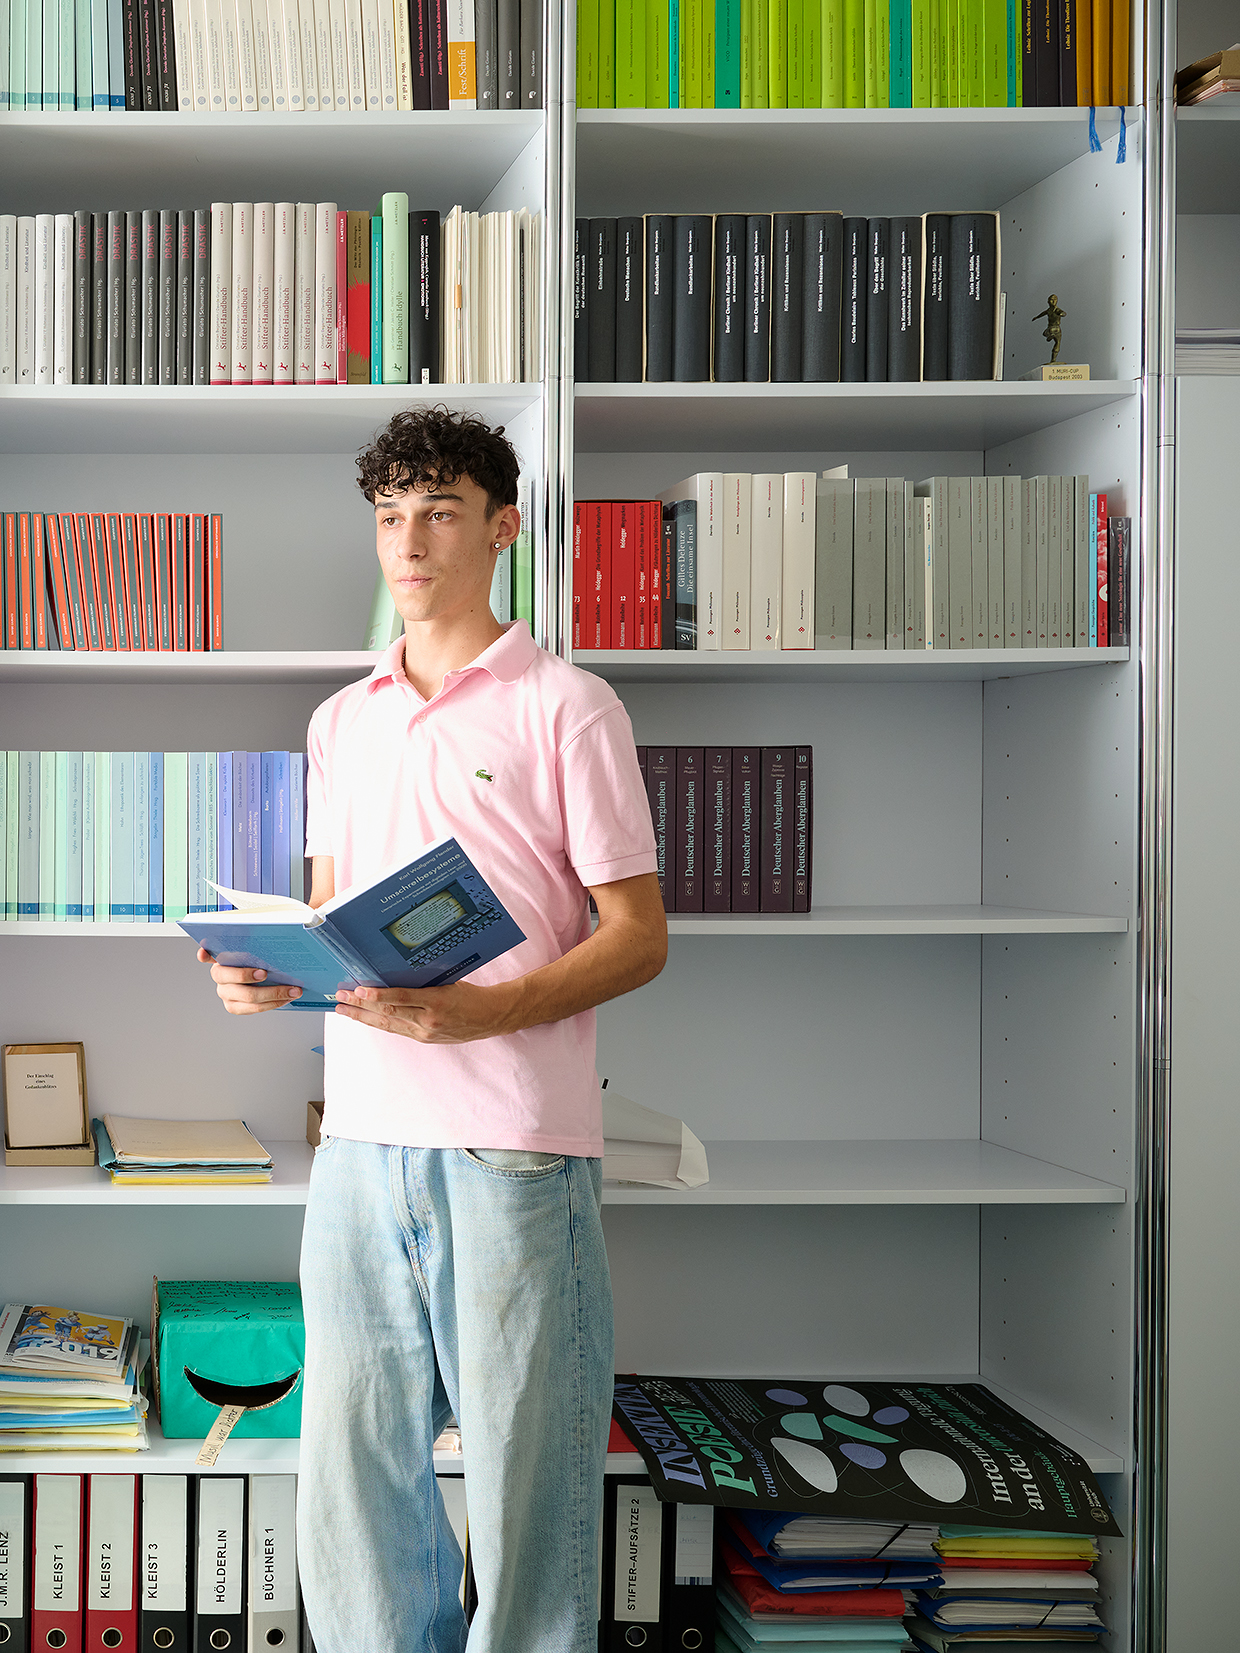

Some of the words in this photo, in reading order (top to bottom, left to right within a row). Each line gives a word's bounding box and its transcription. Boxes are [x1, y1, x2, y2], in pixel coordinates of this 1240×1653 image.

[458, 49, 470, 95] Fest/Schrift
[659, 756, 664, 764] 5
[688, 756, 693, 764] 6
[717, 756, 722, 764] 7
[744, 756, 749, 764] 8
[656, 781, 667, 833] Aberglauben
[685, 781, 695, 833] Aberglauben
[714, 780, 724, 833] Aberglauben
[742, 780, 752, 833] Aberglauben
[772, 779, 783, 831] Aberglauben
[797, 780, 807, 833] Aberglauben
[656, 834, 667, 877] Deutscher
[685, 834, 695, 877] Deutscher
[714, 834, 724, 876] Deutscher
[742, 834, 752, 876] Deutscher
[772, 832, 783, 875] Deutscher
[797, 834, 807, 876] Deutscher
[380, 853, 460, 904] Umschreibesysteme
[40, 1337, 119, 1360] 2019
[663, 1406, 758, 1496] POESIE
[1004, 1452, 1034, 1481] der
[1022, 1483, 1046, 1512] an
[0, 1532, 8, 1564] LENZ
[214, 1530, 226, 1602] HÖLDERLIN
[263, 1538, 274, 1600] BÜCHNER
[627, 1508, 639, 1610] STIFTER-AUFSÄTZE
[54, 1555, 63, 1598] KLEIST
[101, 1554, 110, 1598] KLEIST
[148, 1554, 157, 1598] KLEIST
